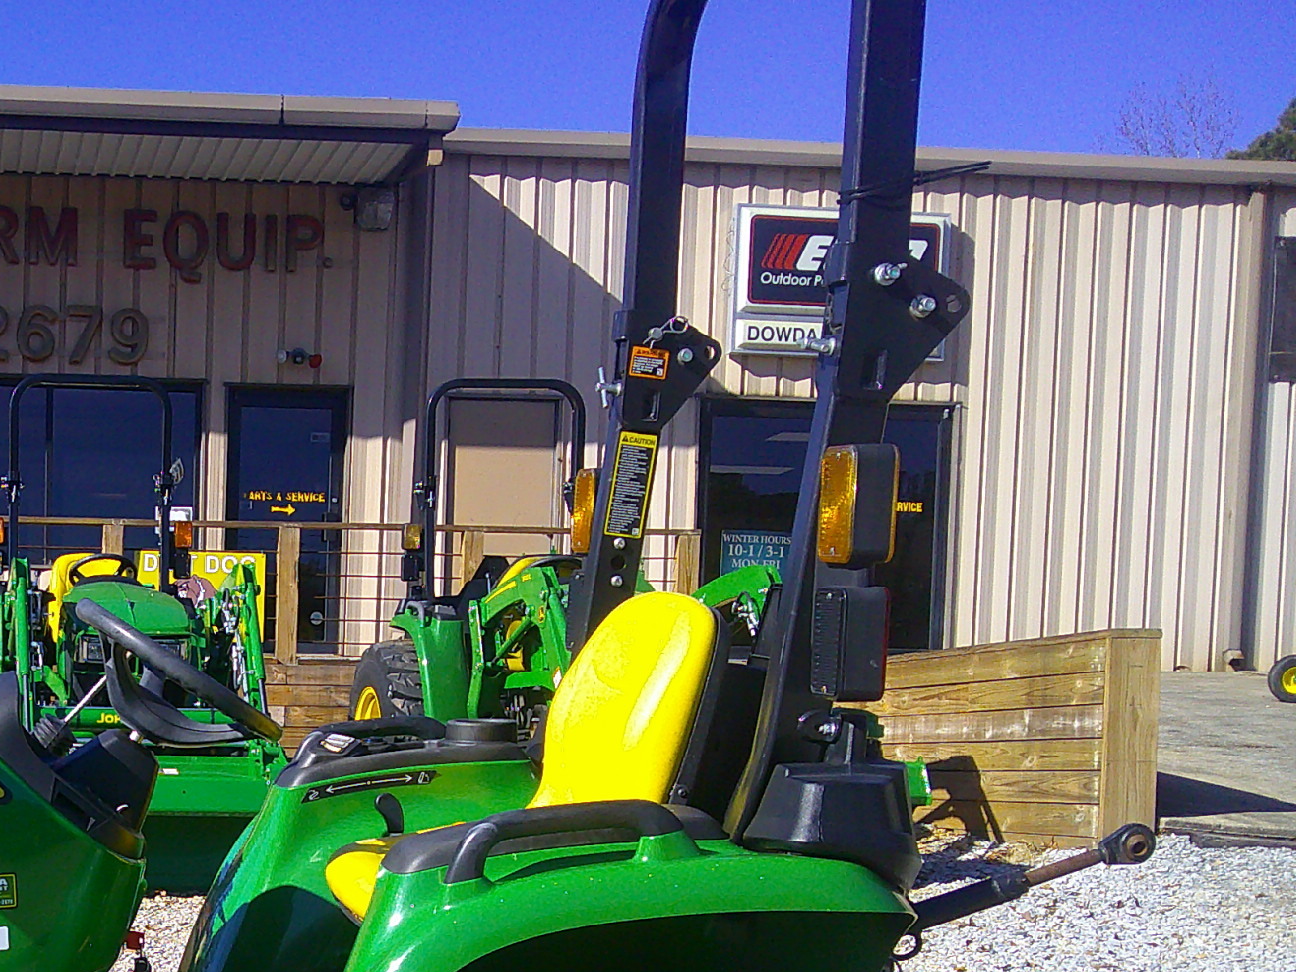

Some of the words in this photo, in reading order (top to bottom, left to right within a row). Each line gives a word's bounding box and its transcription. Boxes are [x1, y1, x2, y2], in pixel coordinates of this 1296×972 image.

[123, 208, 334, 284] EQUIP.
[760, 271, 811, 286] Outdoor
[628, 435, 656, 447] CAUTION
[285, 491, 326, 503] SERVICE
[722, 533, 760, 544] WINTER
[760, 535, 792, 545] HOURS
[728, 543, 754, 557] 10-1
